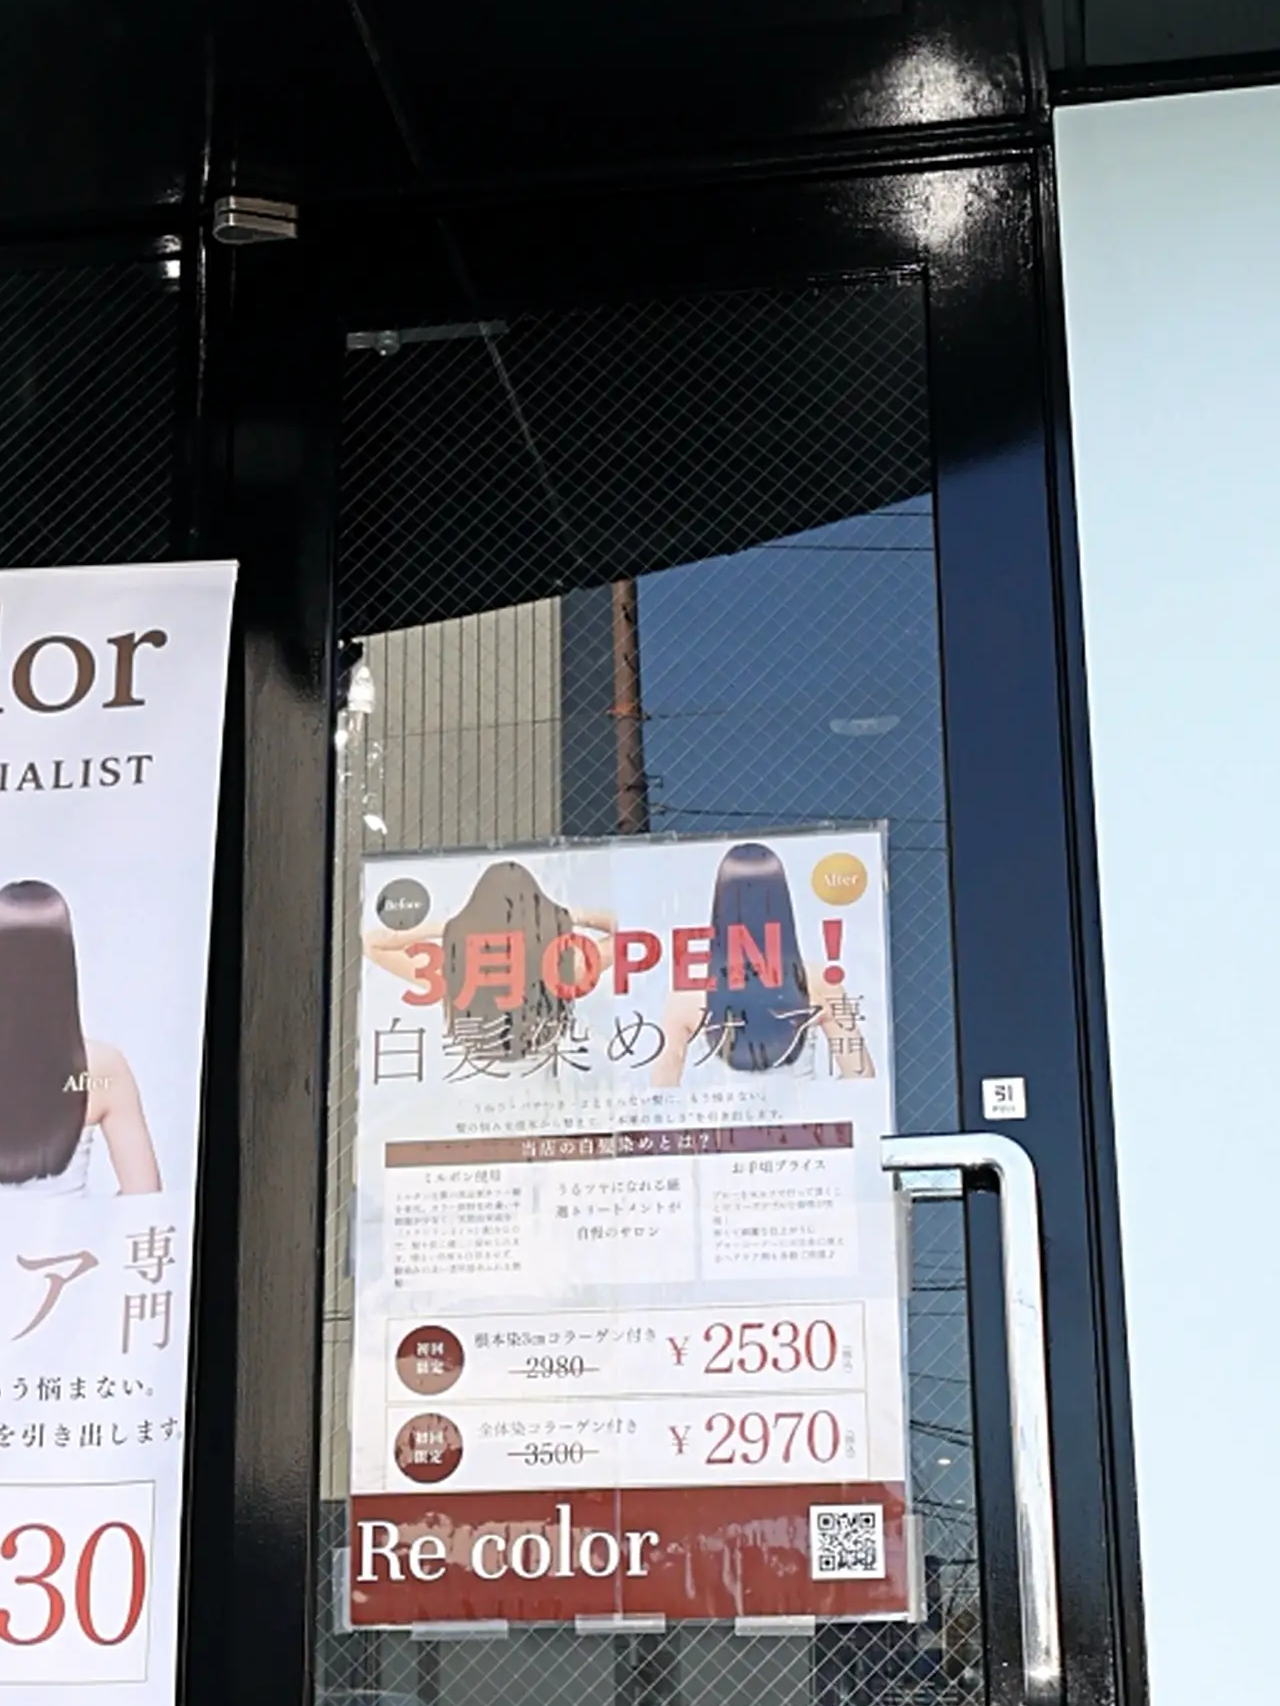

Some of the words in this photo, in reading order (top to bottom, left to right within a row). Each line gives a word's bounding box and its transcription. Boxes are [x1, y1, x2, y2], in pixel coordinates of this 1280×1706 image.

[373, 1004, 823, 1084] 白髪染めケア
[63, 1071, 112, 1093] After
[119, 1225, 177, 1355] 専門
[525, 1355, 585, 1380] 2980
[524, 1442, 584, 1466] 3500
[357, 1520, 448, 1583] Re
[472, 1504, 660, 1579] color
